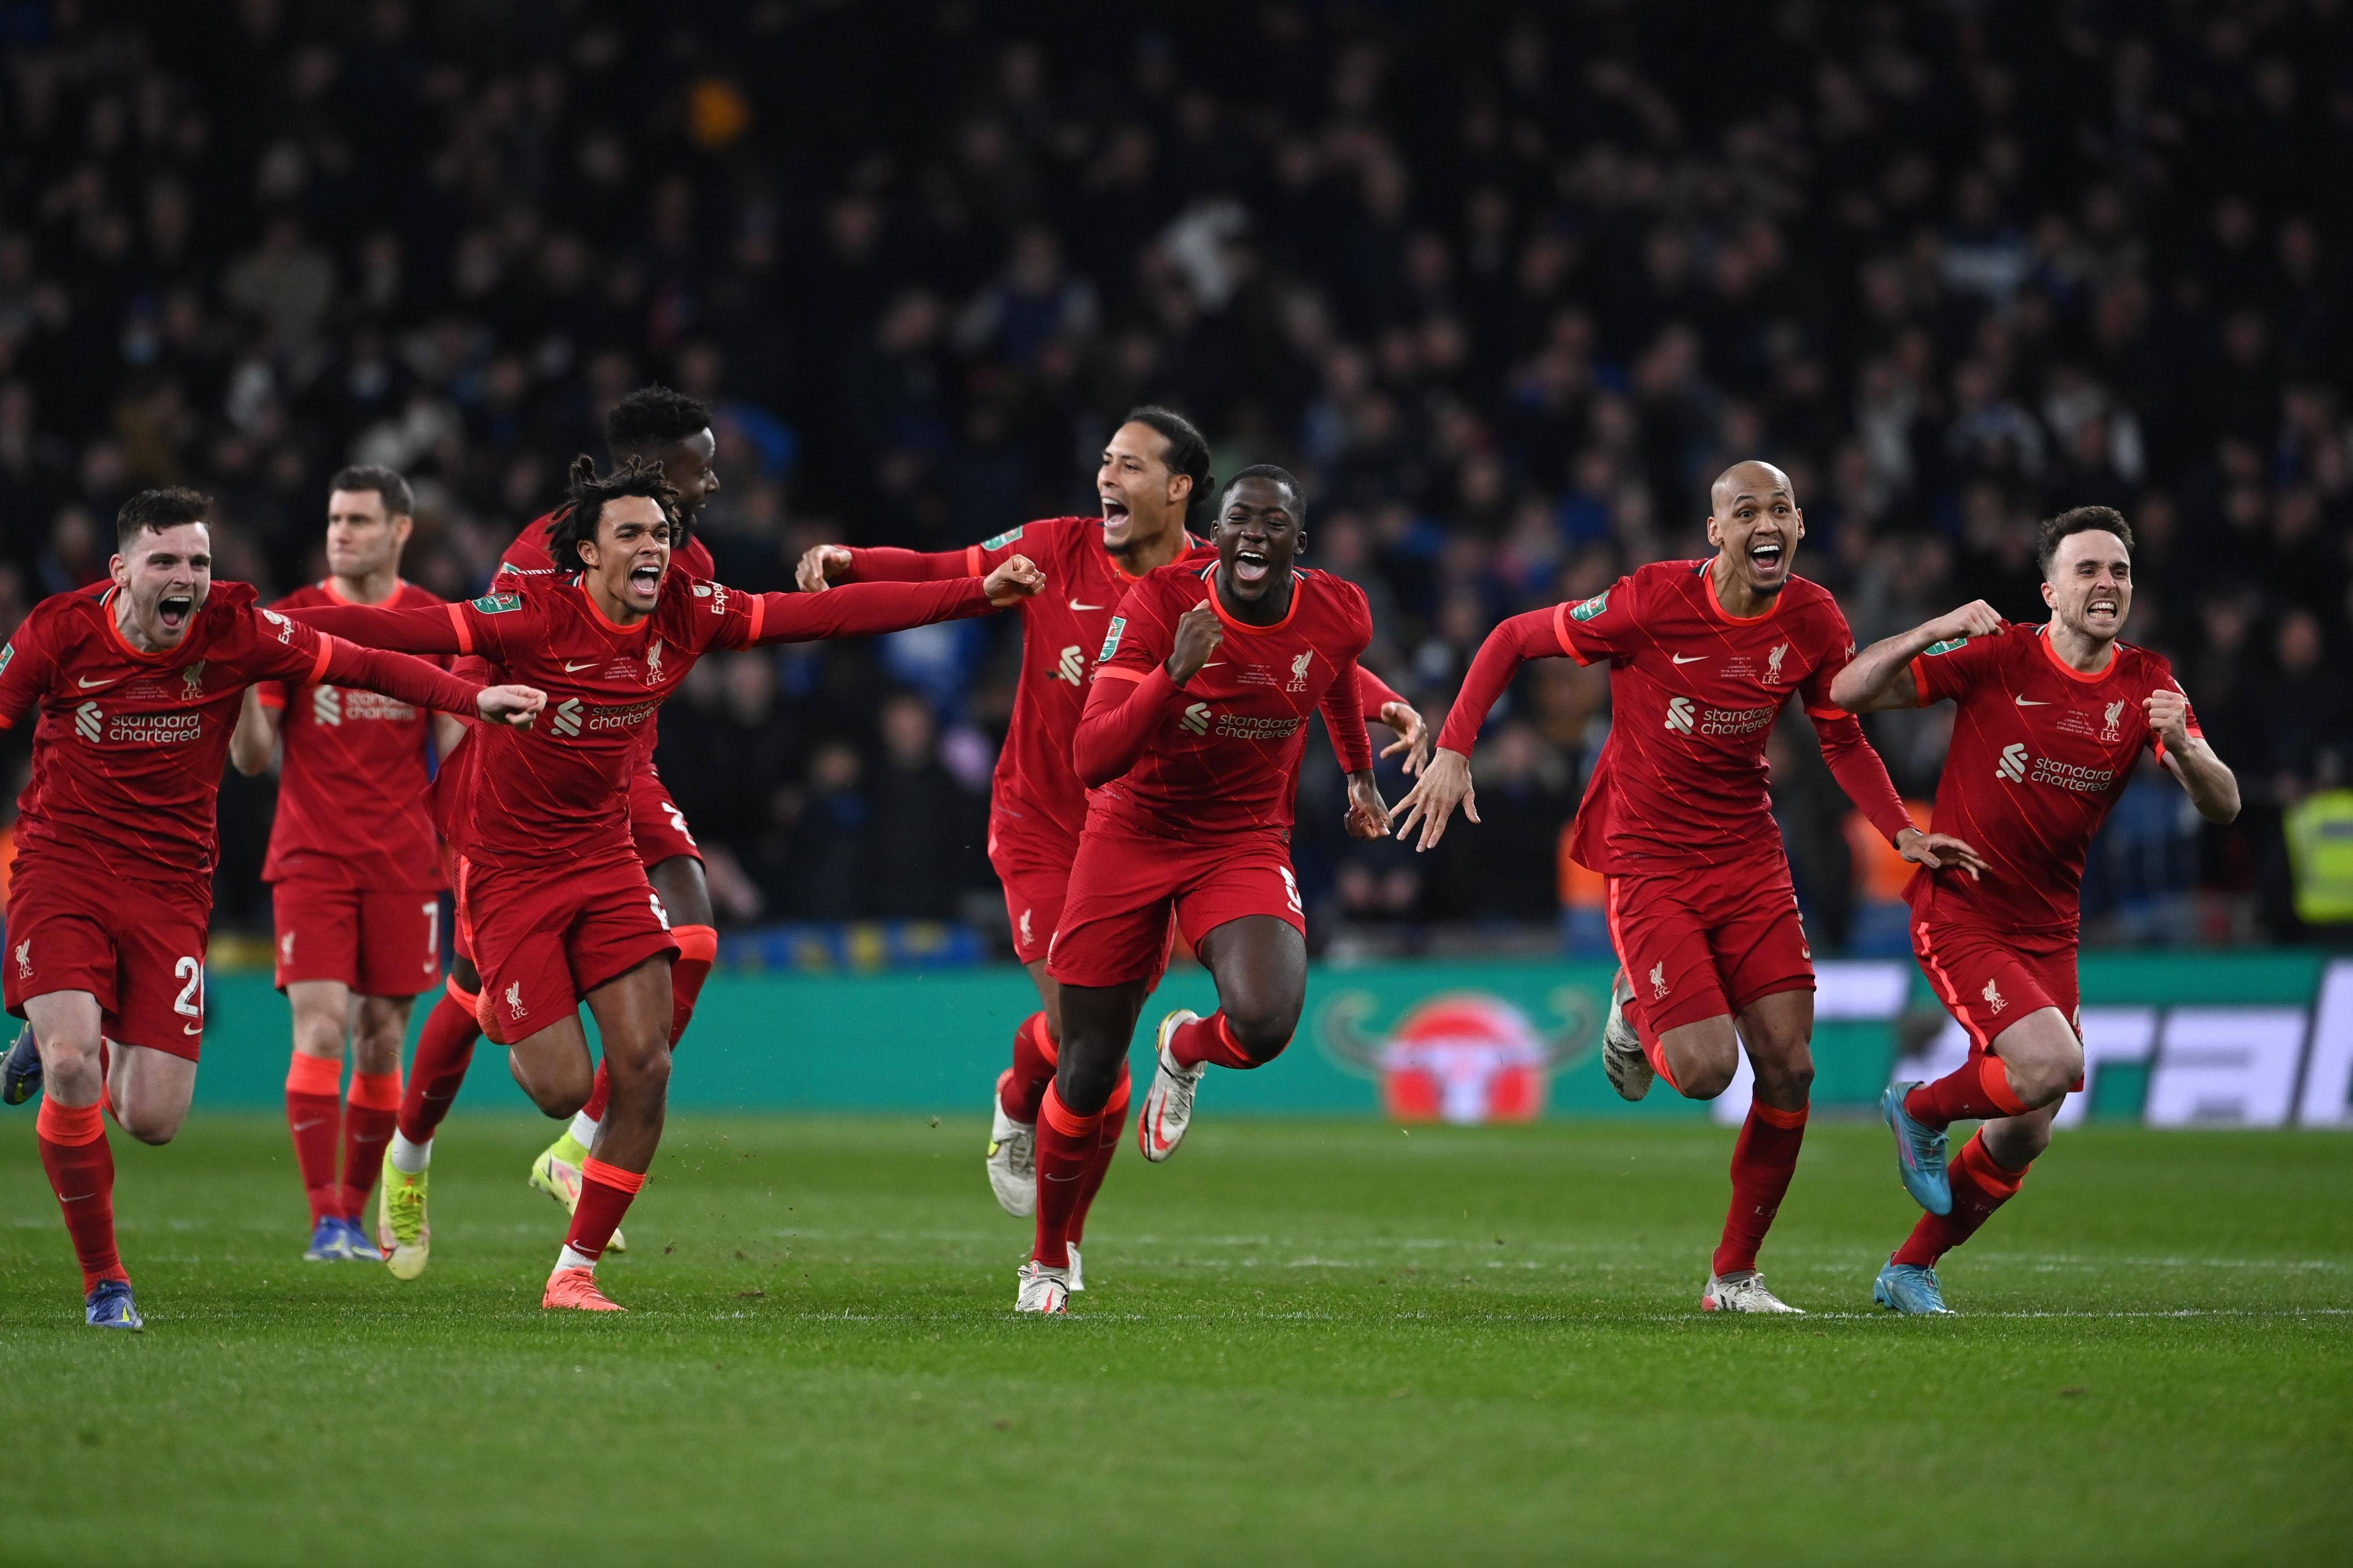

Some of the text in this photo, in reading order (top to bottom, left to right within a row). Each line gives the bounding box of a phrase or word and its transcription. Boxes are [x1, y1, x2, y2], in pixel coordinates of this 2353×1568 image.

[710, 583, 729, 615] Expe
[278, 616, 295, 644] Exp
[1215, 725, 1298, 739] chartered
[1218, 713, 1301, 728] standard
[1701, 710, 1774, 735] chartered
[109, 725, 201, 743] chartered
[2031, 770, 2111, 792] chartered
[2034, 757, 2113, 781] standard
[174, 956, 204, 1018] 2
